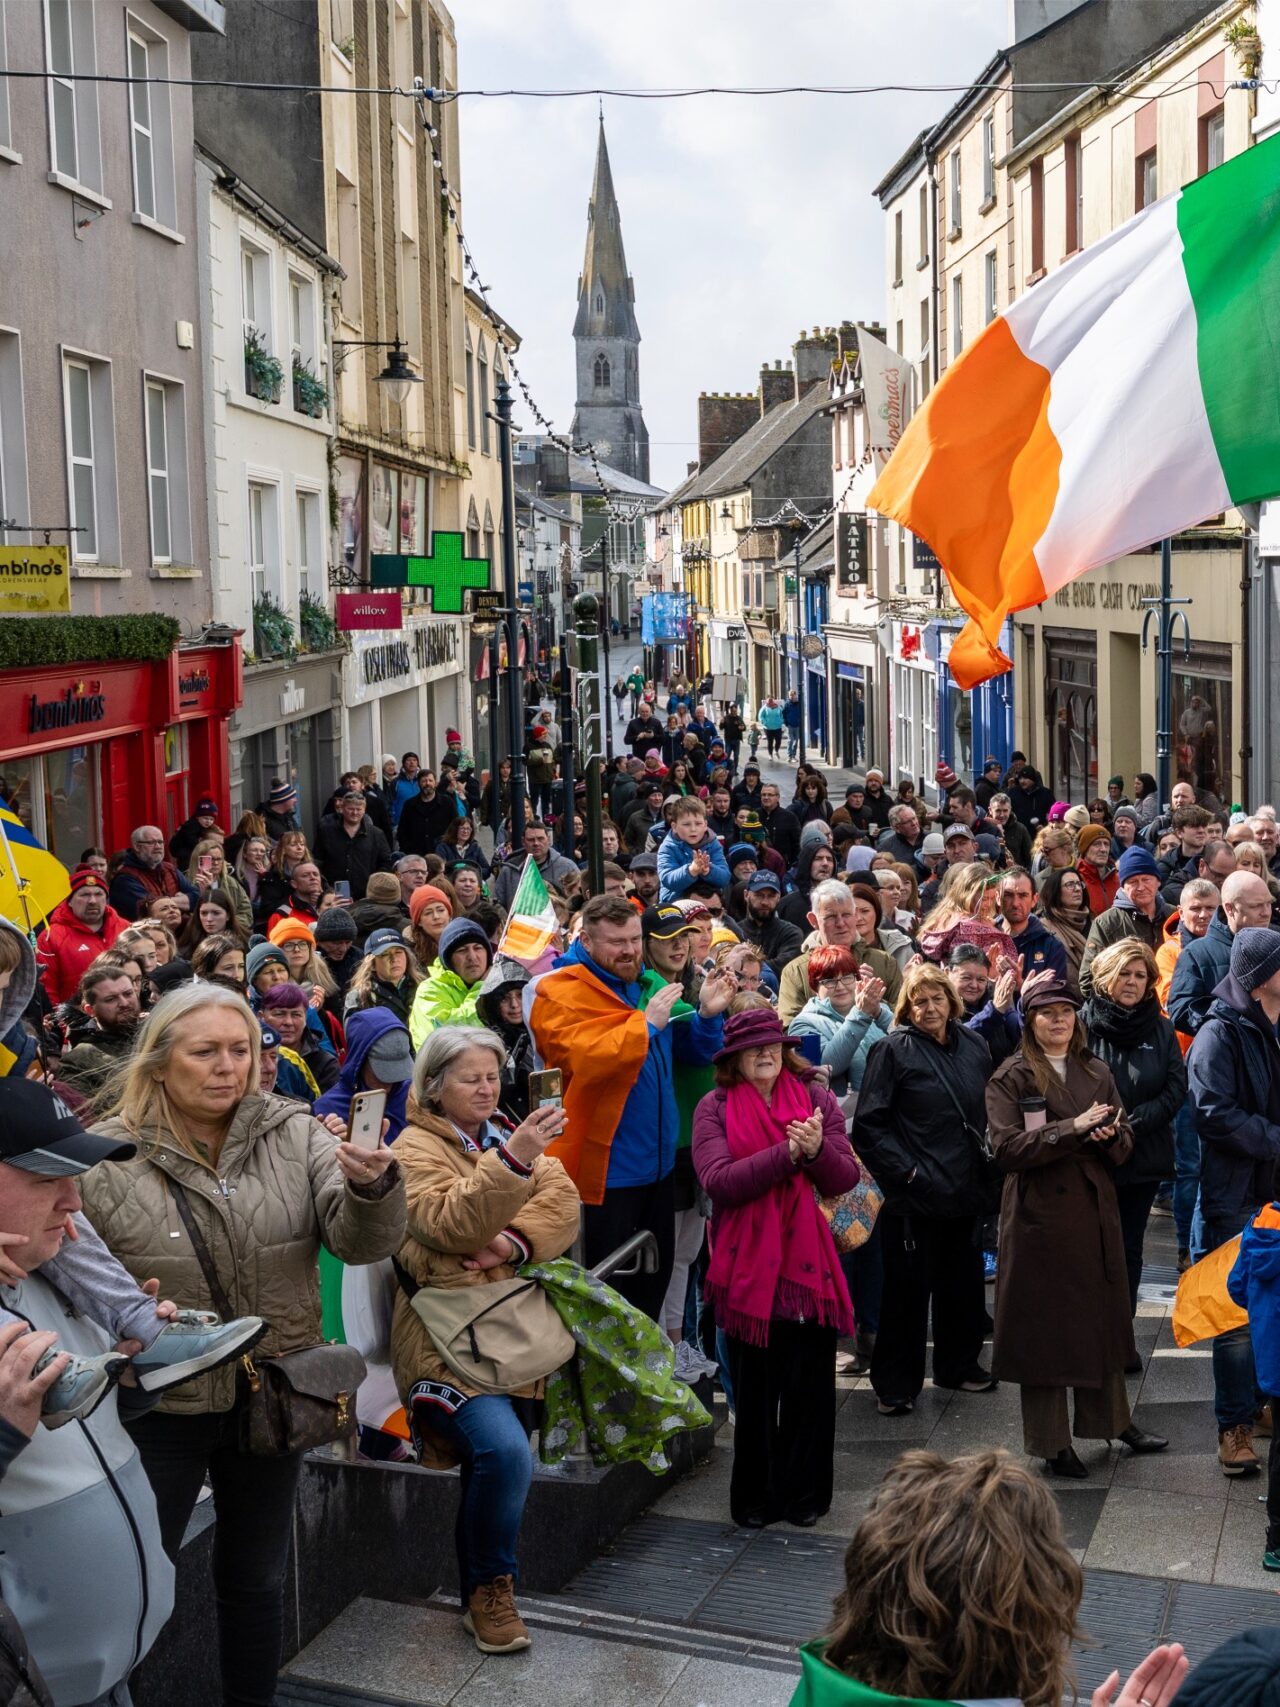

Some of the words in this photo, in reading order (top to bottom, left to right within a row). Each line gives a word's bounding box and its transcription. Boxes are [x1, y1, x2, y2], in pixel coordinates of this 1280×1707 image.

[847, 514, 861, 583] TATTOO
[353, 605, 388, 615] willow
[1072, 582, 1096, 609] ENNIS
[1100, 582, 1123, 610] CASH
